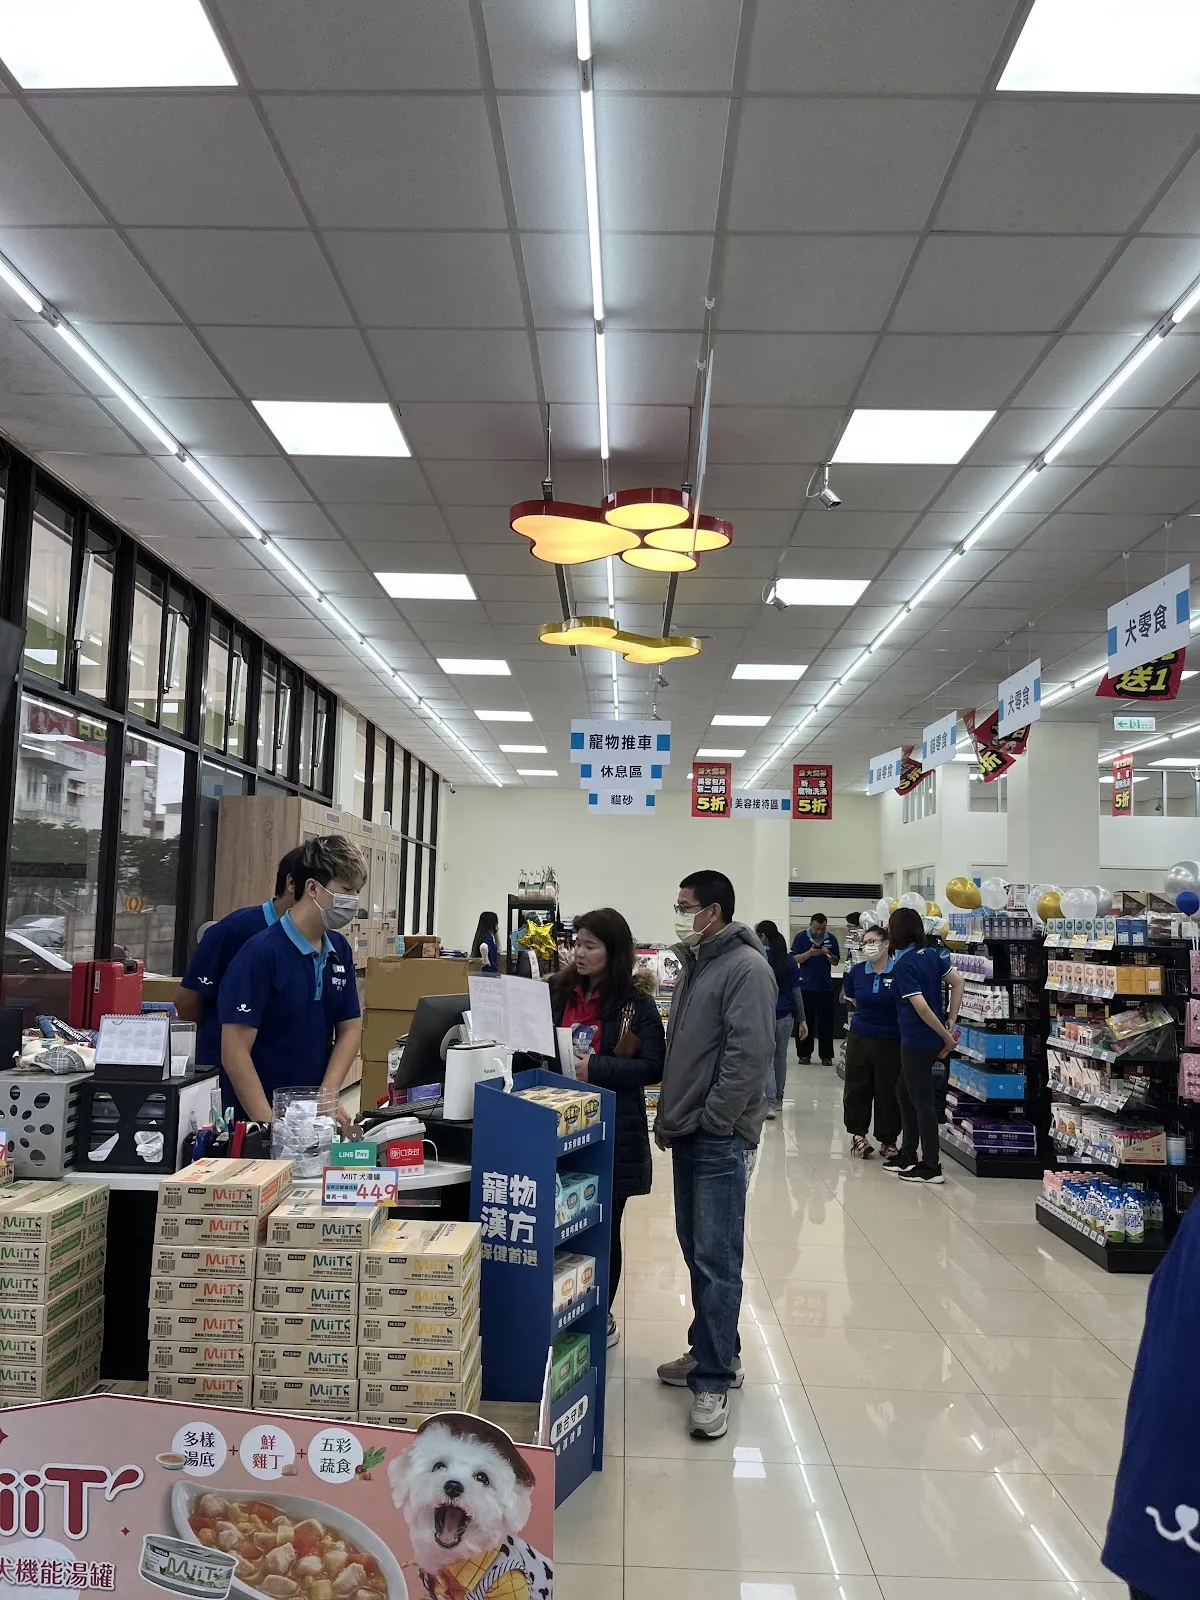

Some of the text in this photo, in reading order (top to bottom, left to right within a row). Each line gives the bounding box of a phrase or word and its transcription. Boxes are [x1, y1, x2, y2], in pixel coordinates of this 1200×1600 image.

[1125, 604, 1168, 647] 犬零食
[1116, 666, 1168, 692] 送1
[1007, 685, 1030, 716] 犬零食
[588, 734, 652, 750] 寵物推車
[600, 765, 642, 778] 休息區
[697, 785, 726, 794] 第二個月
[610, 794, 633, 805] 貓砂
[697, 796, 726, 812] 5折
[734, 798, 779, 810] 美容接待區
[798, 798, 827, 814] 5折
[1115, 790, 1130, 809] 5折
[212, 1188, 251, 1201] MiiT
[356, 1184, 396, 1200] 449
[482, 1171, 537, 1208] 寵物
[3, 1216, 41, 1230] MiiT
[209, 1220, 248, 1232] MiiT
[322, 1224, 361, 1236] MiiT
[480, 1206, 537, 1244] 漢方
[1, 1247, 39, 1260] MiiT
[206, 1254, 245, 1266] MiiT
[480, 1242, 538, 1267] 保健首選
[313, 1255, 352, 1268] MiiT
[203, 1283, 243, 1296] MiiT
[311, 1288, 350, 1301] MiiT
[203, 1318, 243, 1331] MiiT
[310, 1318, 350, 1332] MiiT
[203, 1348, 243, 1360] MiiT
[308, 1352, 348, 1365] MiiT
[202, 1379, 242, 1392] MiiT
[309, 1384, 349, 1397] MiiT
[184, 1431, 215, 1448] 多樣
[260, 1434, 276, 1451] 鮮
[320, 1437, 351, 1453] 五彩
[184, 1451, 215, 1468] 湯底
[252, 1454, 285, 1470] 雞丁
[320, 1458, 351, 1474] 蔬食
[0, 1557, 113, 1588] 犬機能湯罐
[167, 1557, 217, 1581] MiiT
